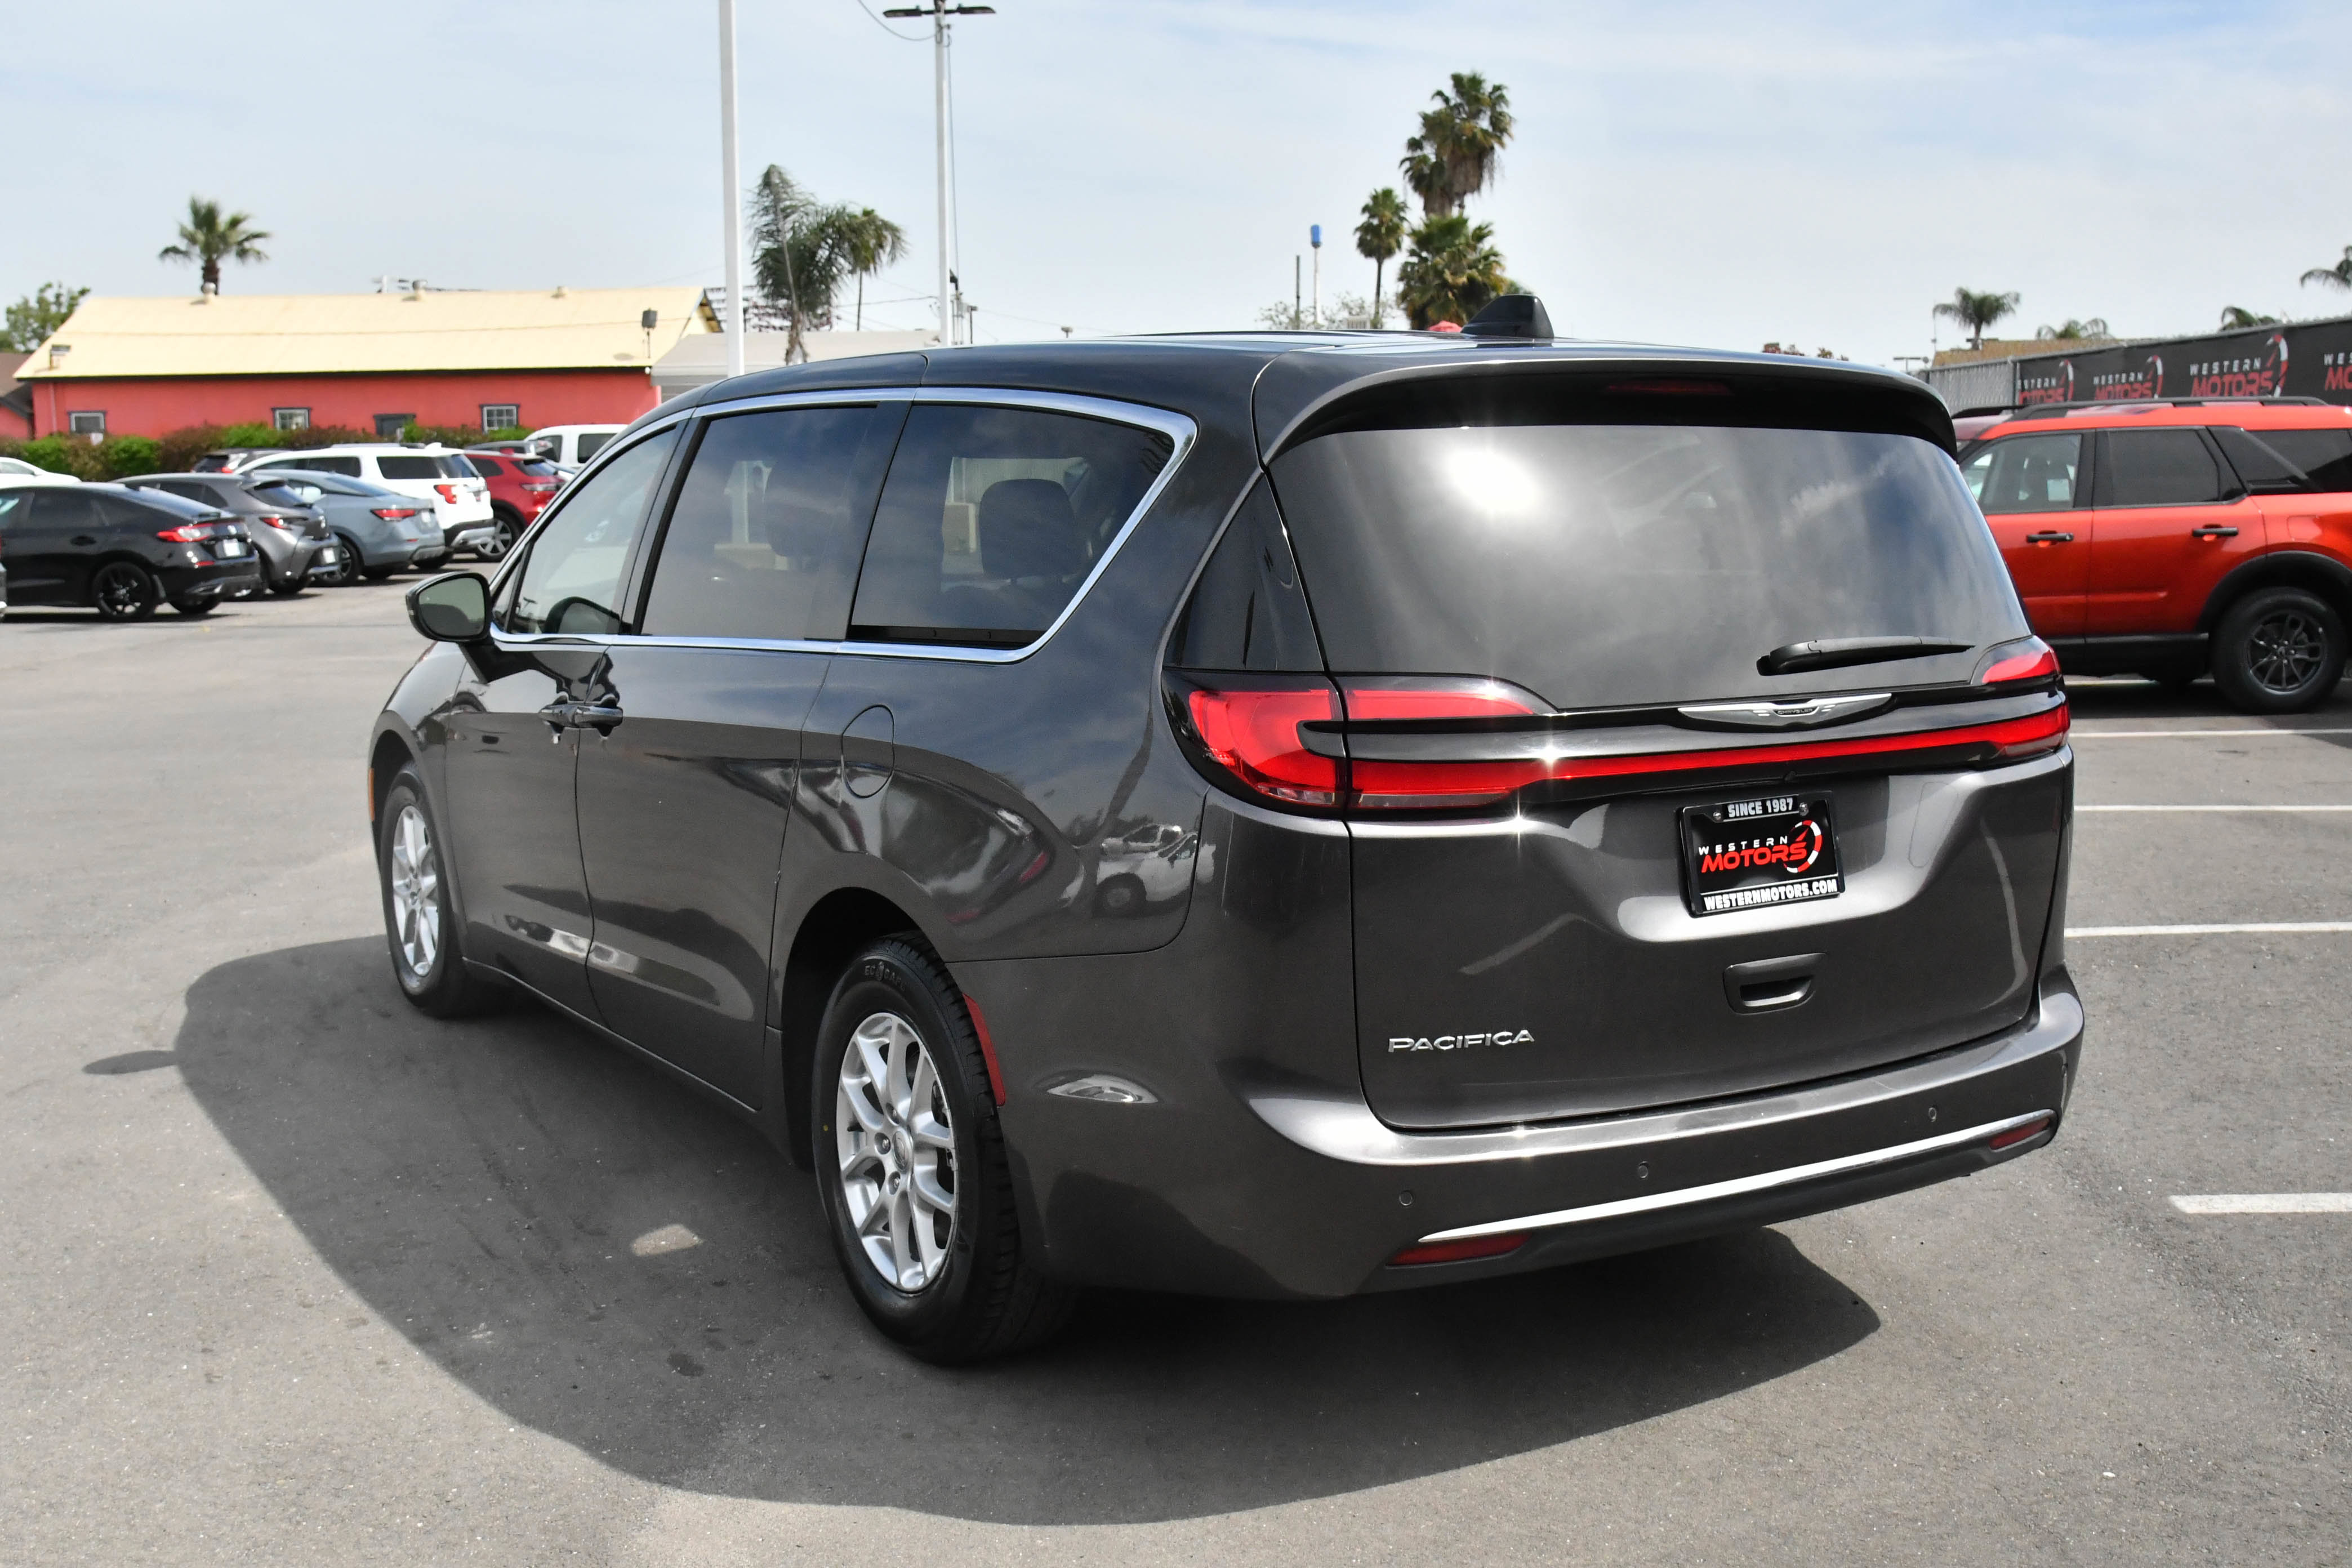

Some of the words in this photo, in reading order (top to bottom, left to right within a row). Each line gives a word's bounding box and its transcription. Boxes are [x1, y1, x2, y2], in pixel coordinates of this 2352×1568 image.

[2190, 357, 2261, 376] WESTERN
[2093, 372, 2143, 385] WESTERN
[2191, 370, 2273, 397] MOTORS
[2095, 381, 2153, 400] MOTORS
[1727, 801, 1763, 817] SINCE
[1766, 798, 1793, 813] 1987
[1699, 836, 1788, 856] WESTERN
[1701, 841, 1807, 873] MOTORS
[1704, 879, 1838, 911] WESTERNMOTORS.COM
[1388, 1029, 1535, 1053] PACIFICA
